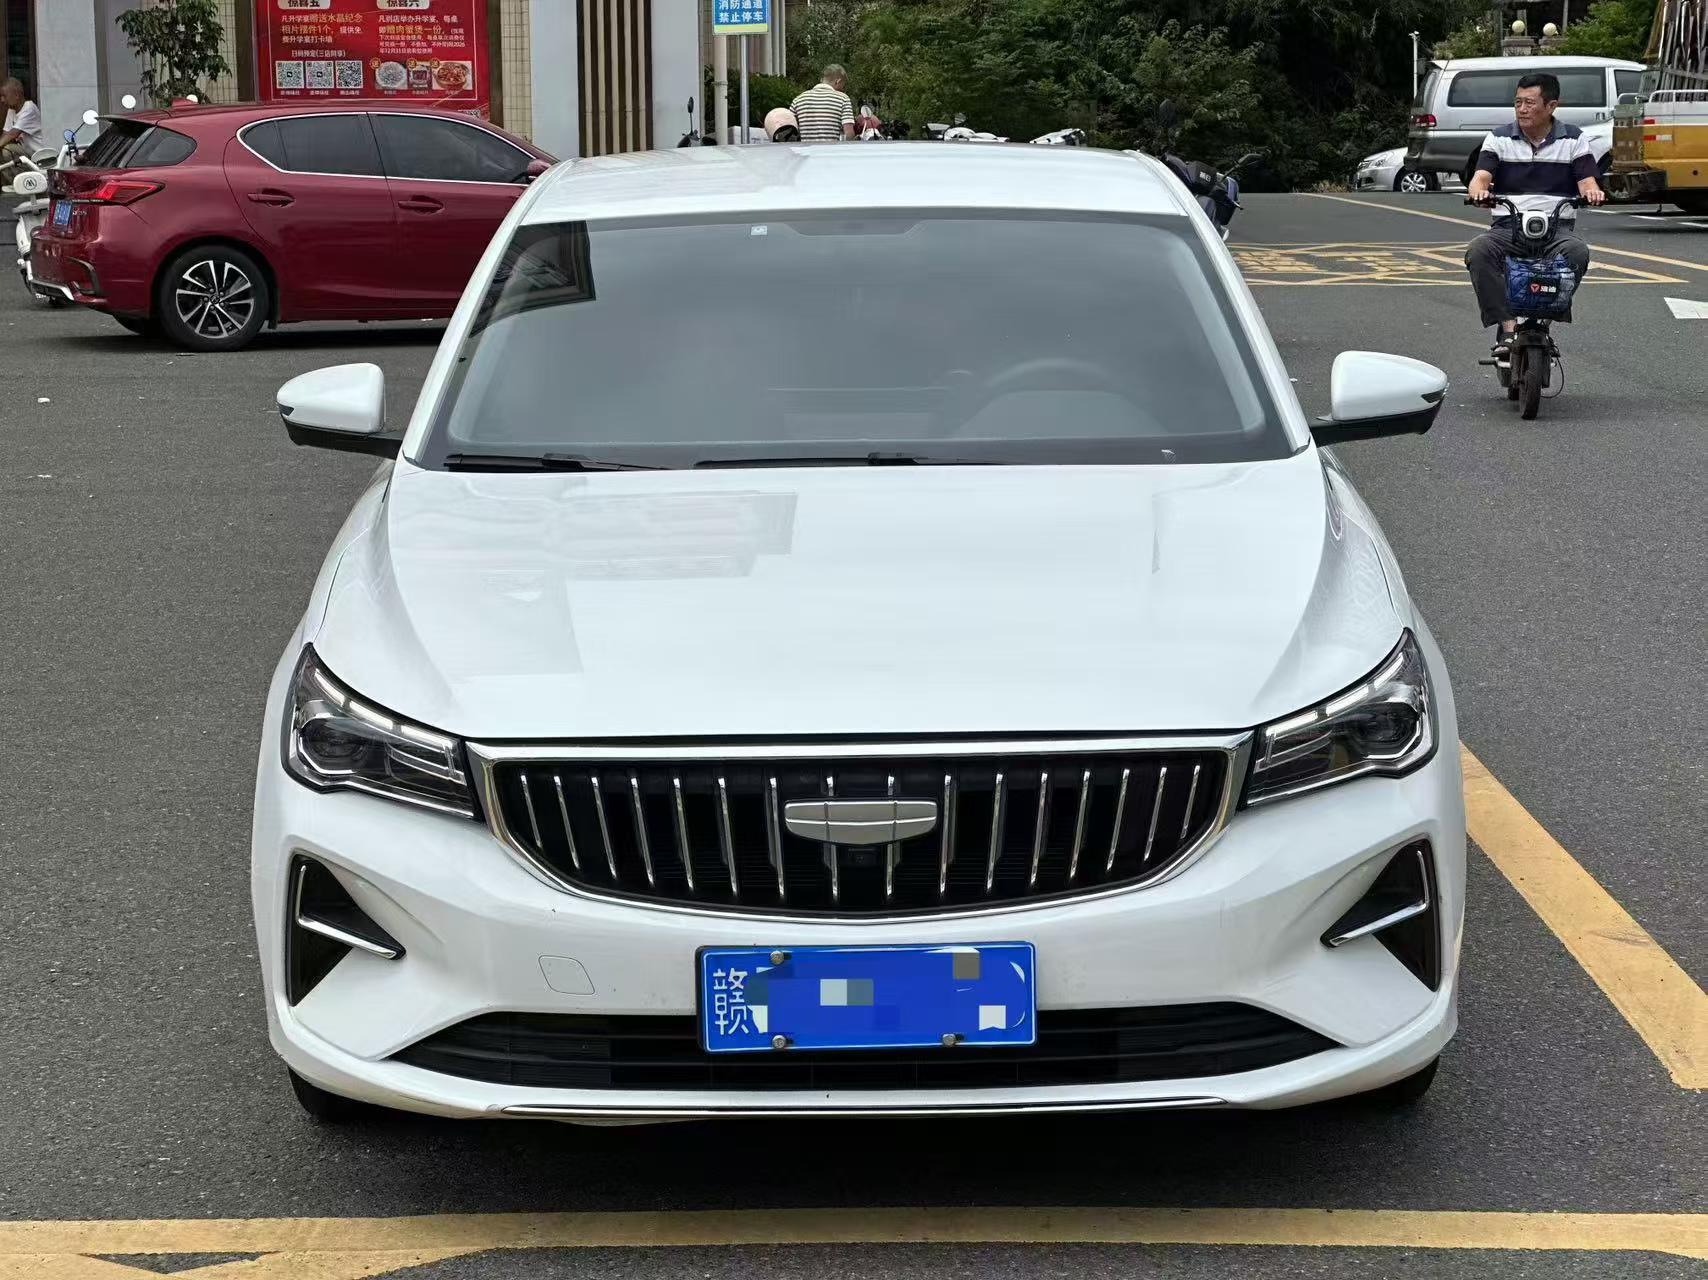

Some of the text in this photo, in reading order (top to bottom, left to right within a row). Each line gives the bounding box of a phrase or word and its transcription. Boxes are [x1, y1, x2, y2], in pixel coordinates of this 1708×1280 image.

[719, 0, 763, 9] 消防通道
[719, 11, 763, 23] 禁止停车
[713, 967, 749, 1036] 赣
